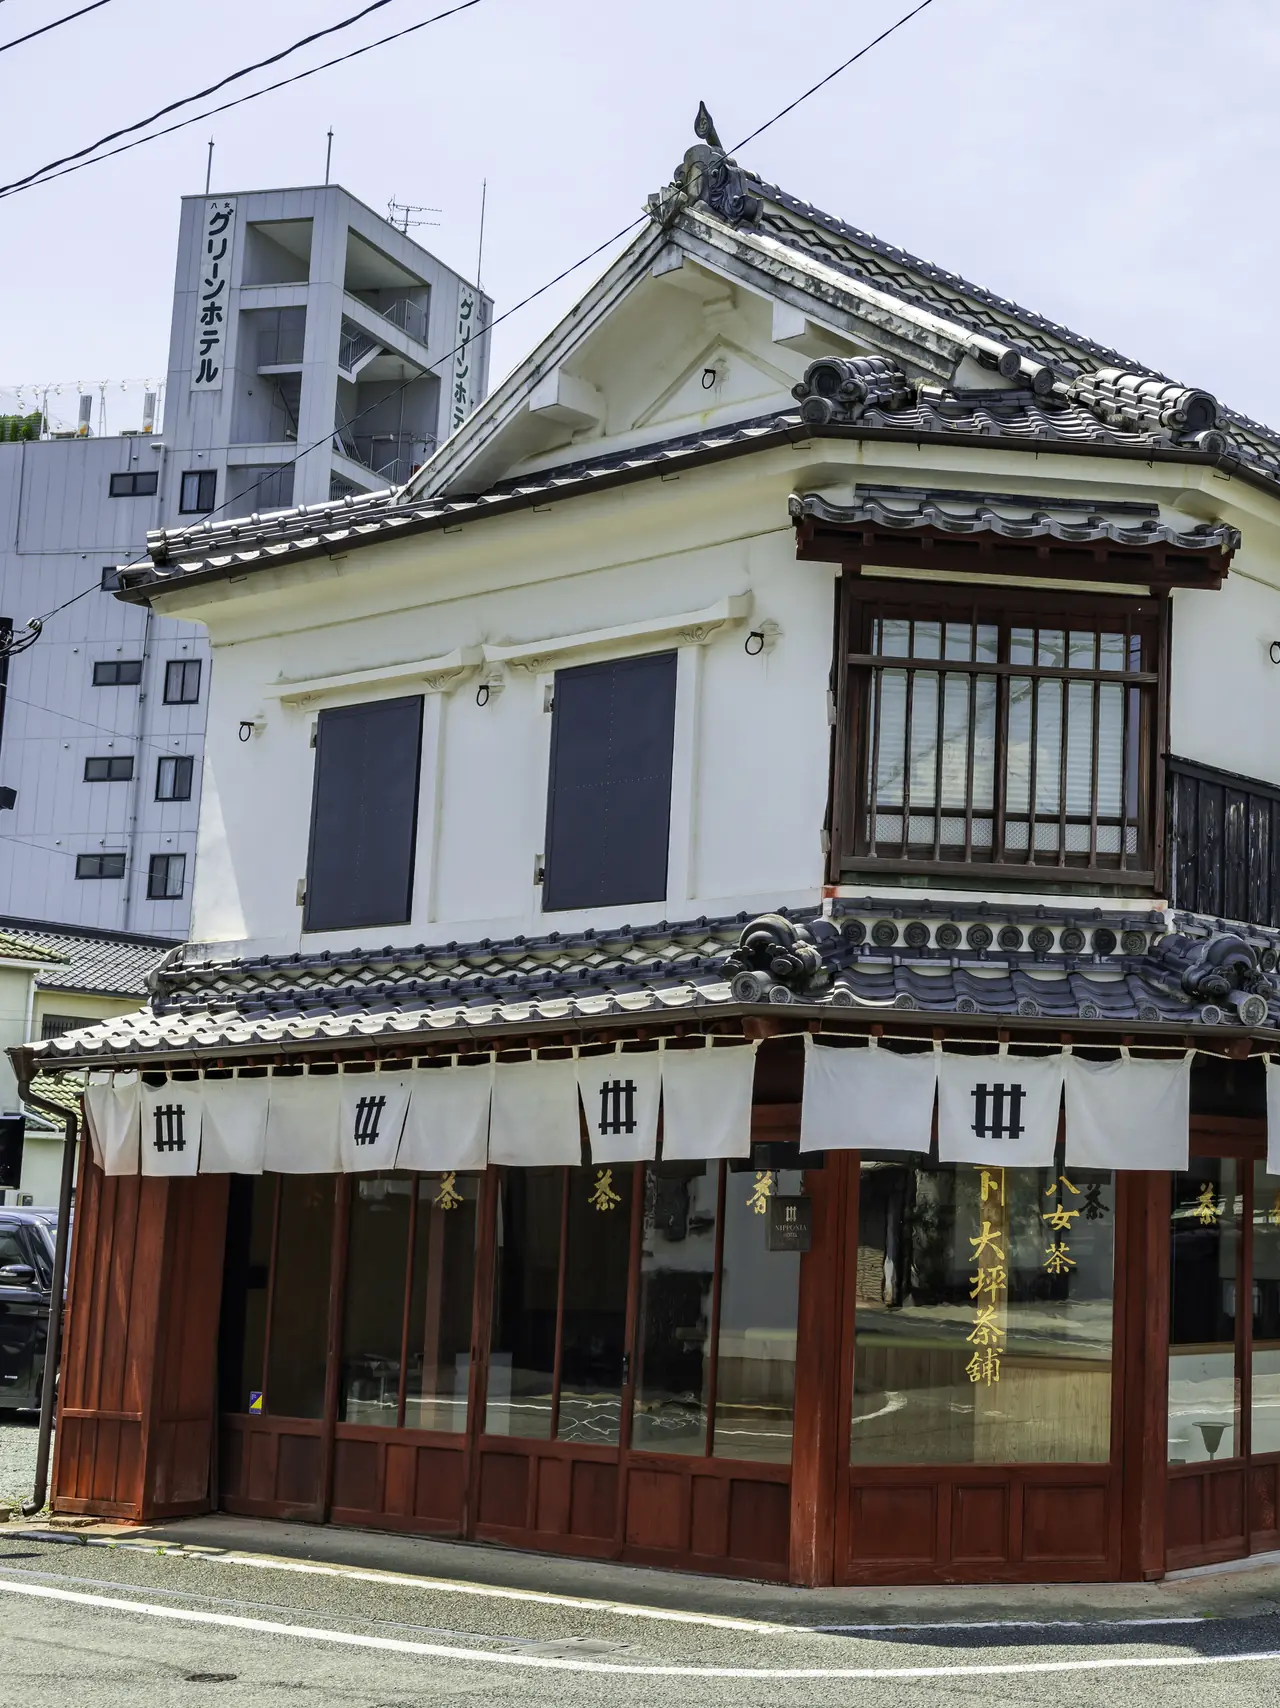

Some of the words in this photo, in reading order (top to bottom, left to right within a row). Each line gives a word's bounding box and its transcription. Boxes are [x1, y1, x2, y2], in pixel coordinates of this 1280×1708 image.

[210, 202, 231, 210] 八女
[195, 208, 234, 383] グリーンホテル
[434, 1171, 464, 1210] 茶
[587, 1168, 622, 1211] 茶
[1192, 1181, 1221, 1225] 茶
[1043, 1175, 1081, 1274] 八女茶
